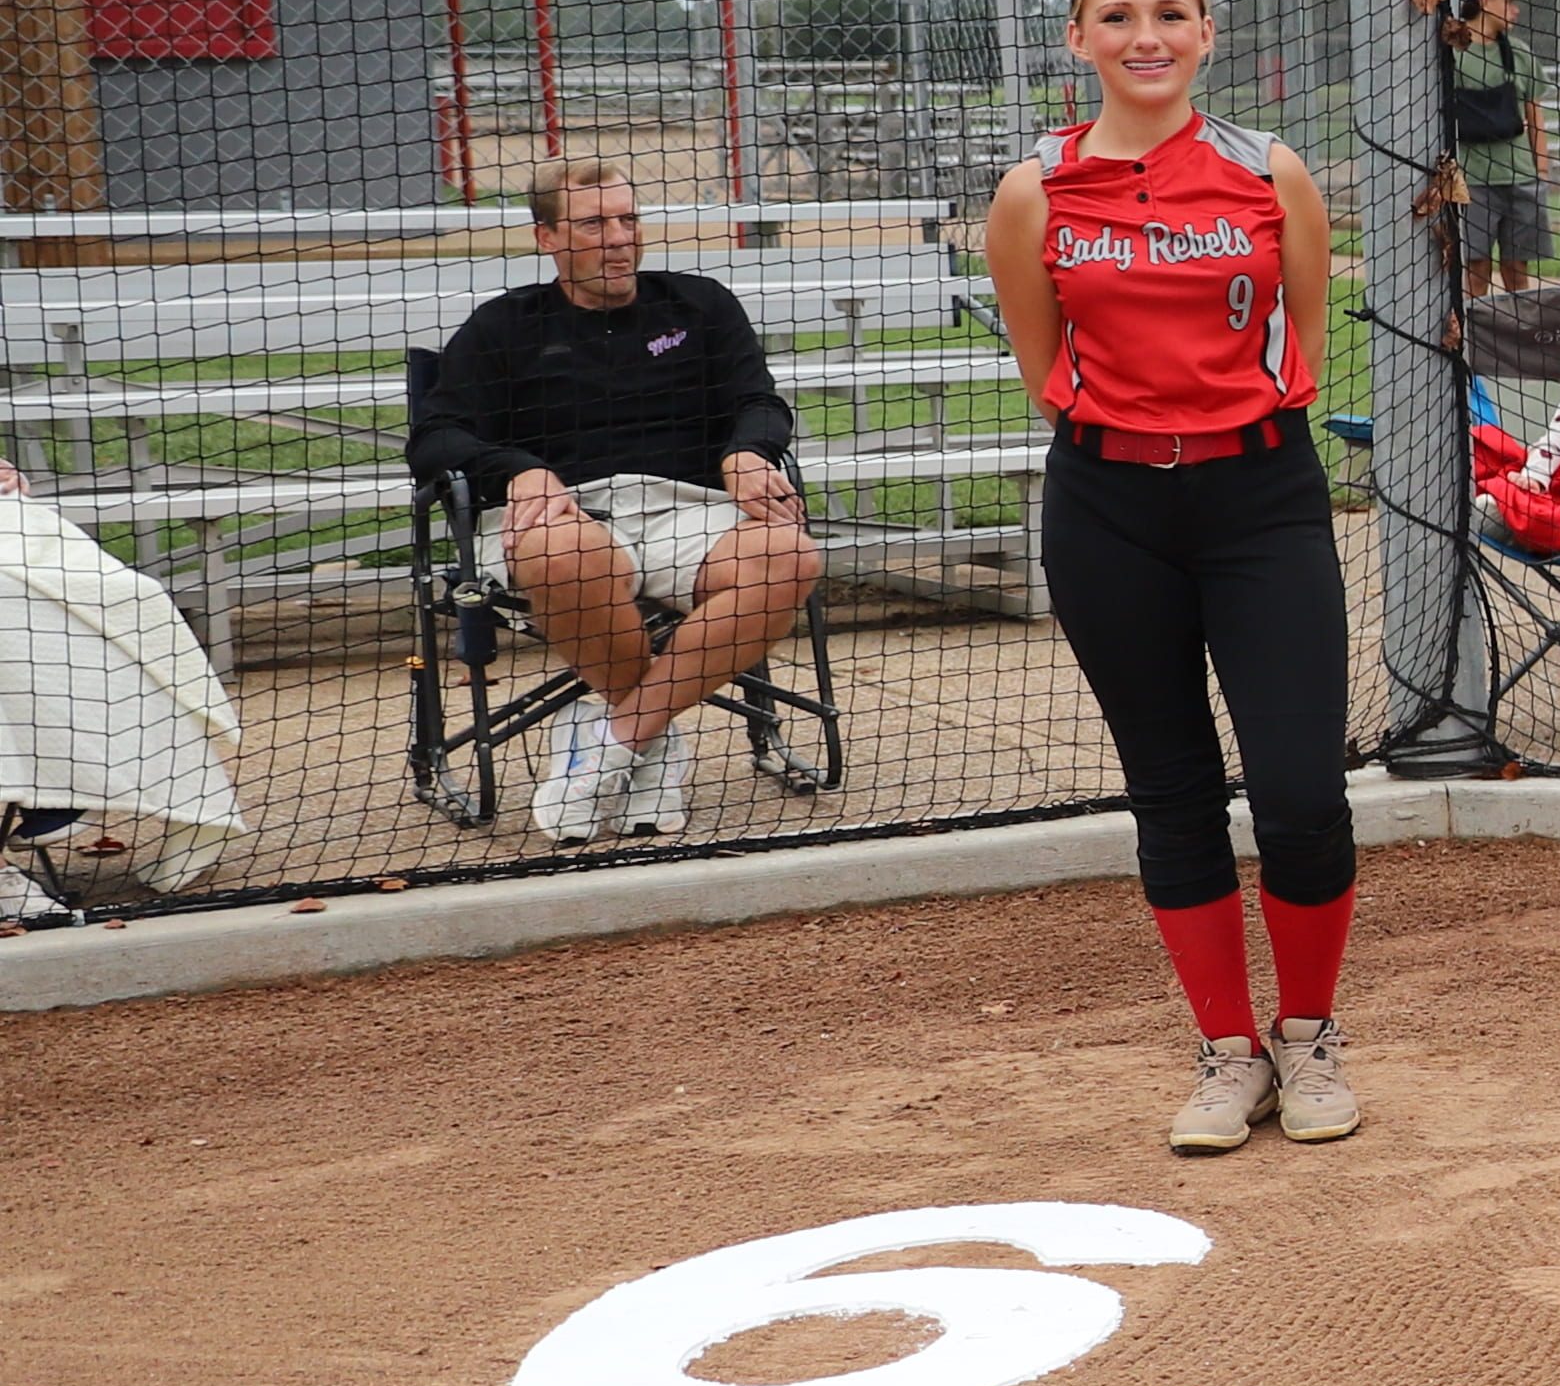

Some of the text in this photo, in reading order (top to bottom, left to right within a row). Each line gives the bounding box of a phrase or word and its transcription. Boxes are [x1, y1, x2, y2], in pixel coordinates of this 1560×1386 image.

[1056, 216, 1253, 271] Lady Rebels
[1227, 273, 1255, 331] 9
